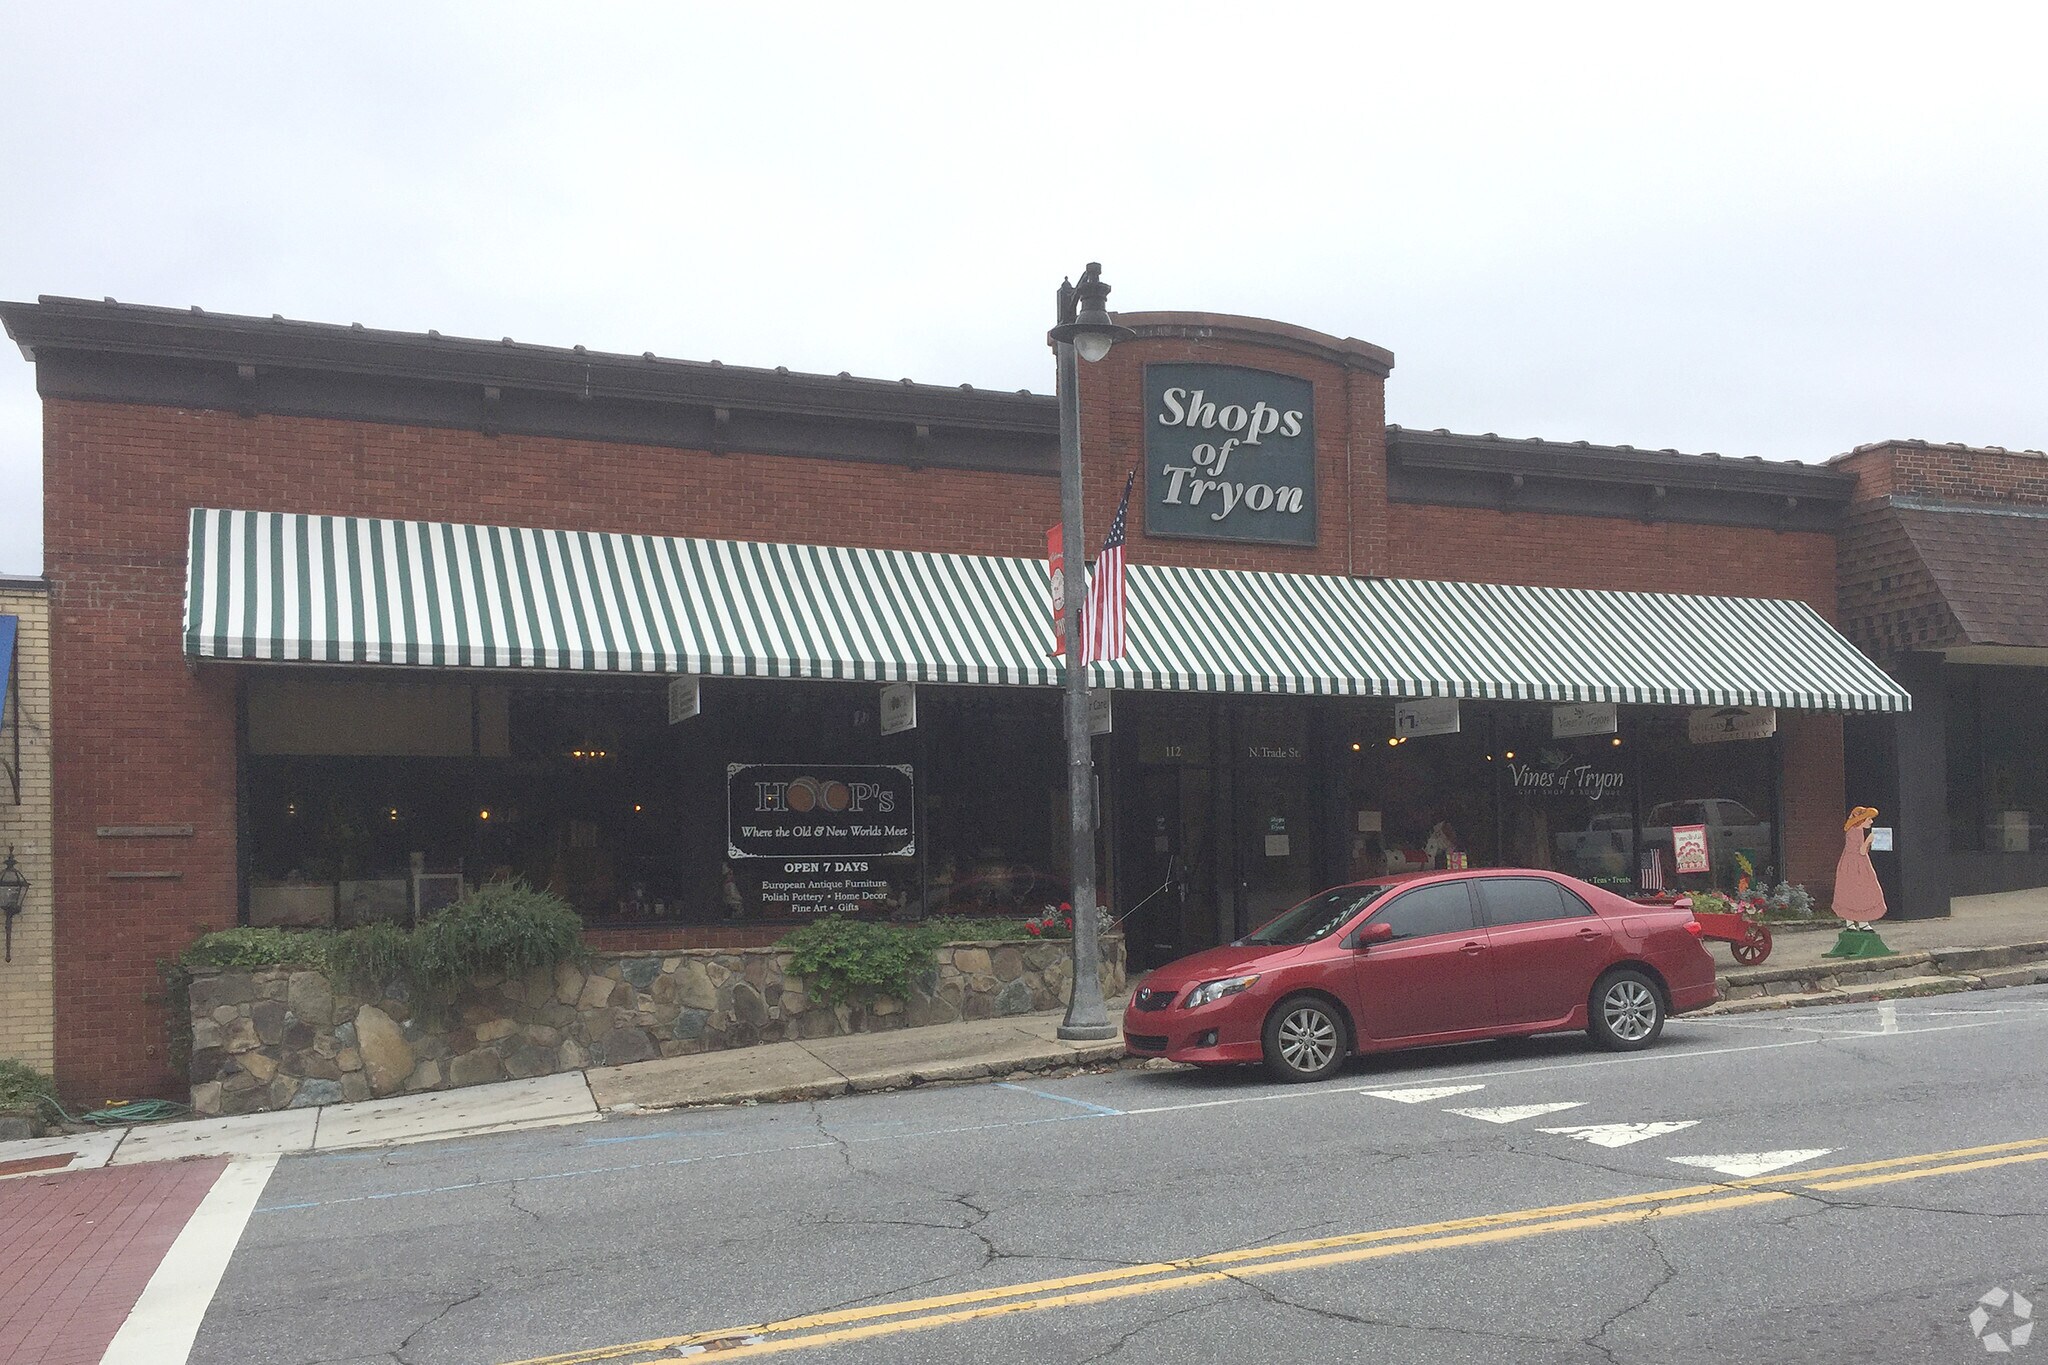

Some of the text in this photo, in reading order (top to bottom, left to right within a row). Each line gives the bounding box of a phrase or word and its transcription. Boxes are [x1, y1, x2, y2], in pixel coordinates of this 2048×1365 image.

[1159, 387, 1303, 445] Shops
[1192, 438, 1239, 476] of
[1162, 464, 1304, 521] Tryon
[1165, 746, 1182, 757] 112
[1249, 747, 1260, 758] N.
[1261, 746, 1286, 758] Trade
[1507, 763, 1624, 800] Vines of Tryon
[755, 777, 895, 813] HOOP's
[741, 825, 909, 838] Where the Old & New Worlds Meet
[784, 861, 869, 873] OPEN 7 DAYS
[762, 879, 887, 892] European Antique Furniture
[762, 891, 888, 903] Polish Pottery Home Decor
[792, 902, 860, 913] Fine Art Gifts
